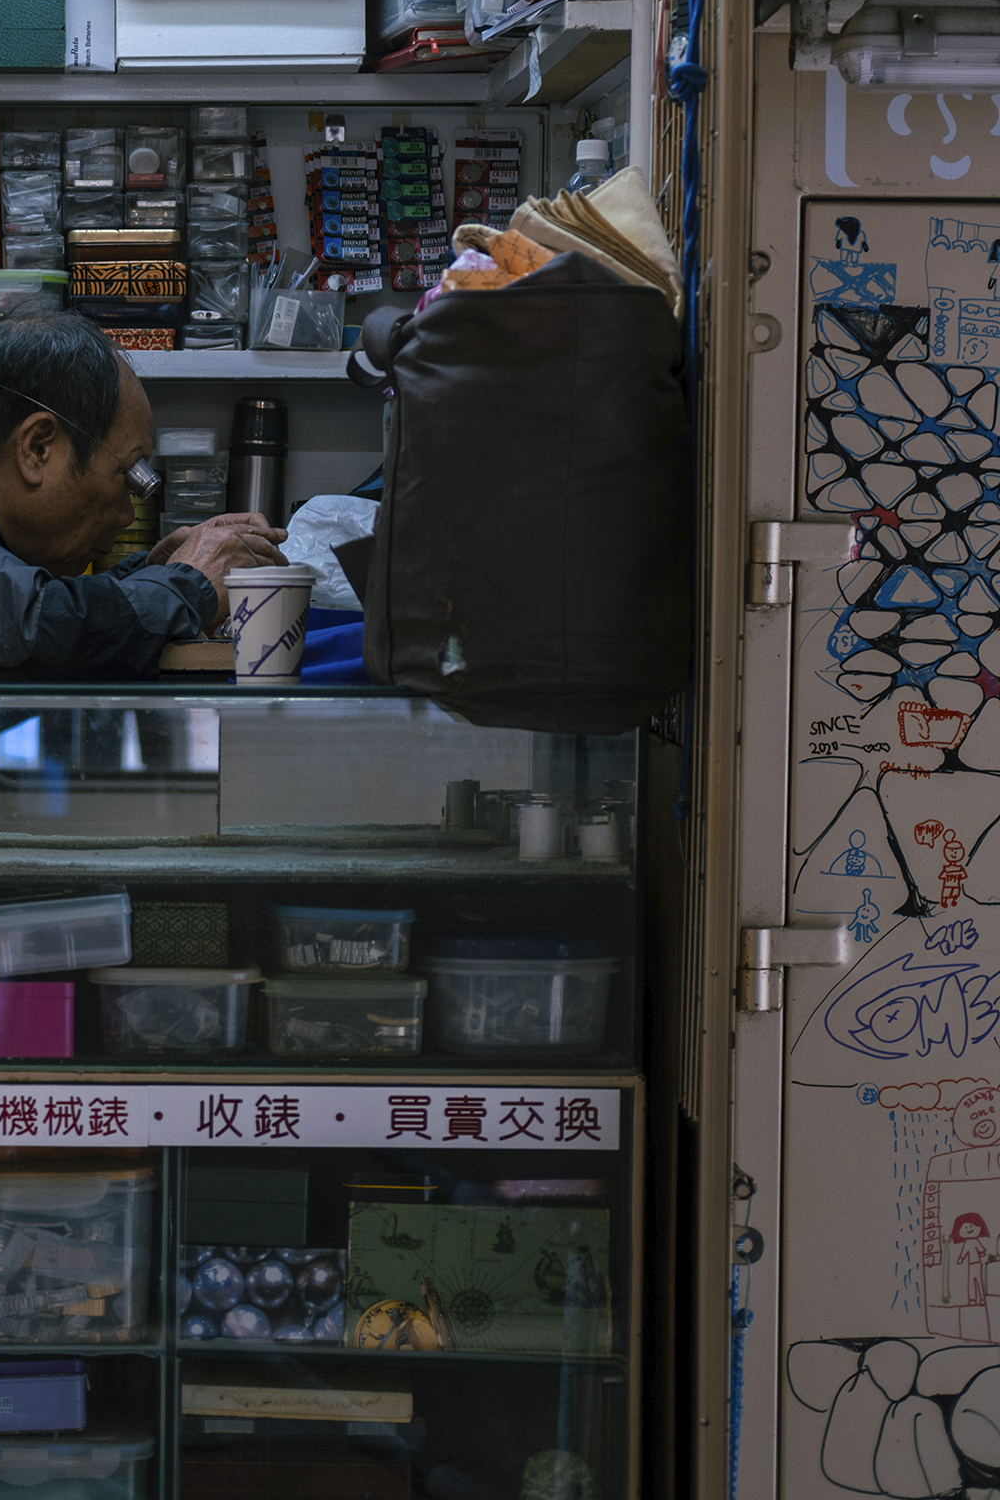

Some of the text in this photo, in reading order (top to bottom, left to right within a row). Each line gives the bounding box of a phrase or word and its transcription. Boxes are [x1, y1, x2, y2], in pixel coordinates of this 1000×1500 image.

[422, 237, 447, 245] maxell
[355, 269, 380, 277] maxell
[356, 278, 380, 286] CR2032
[810, 715, 861, 735] SINCE
[197, 1093, 300, 1140] 收錶
[386, 1094, 602, 1142] 買賣交換
